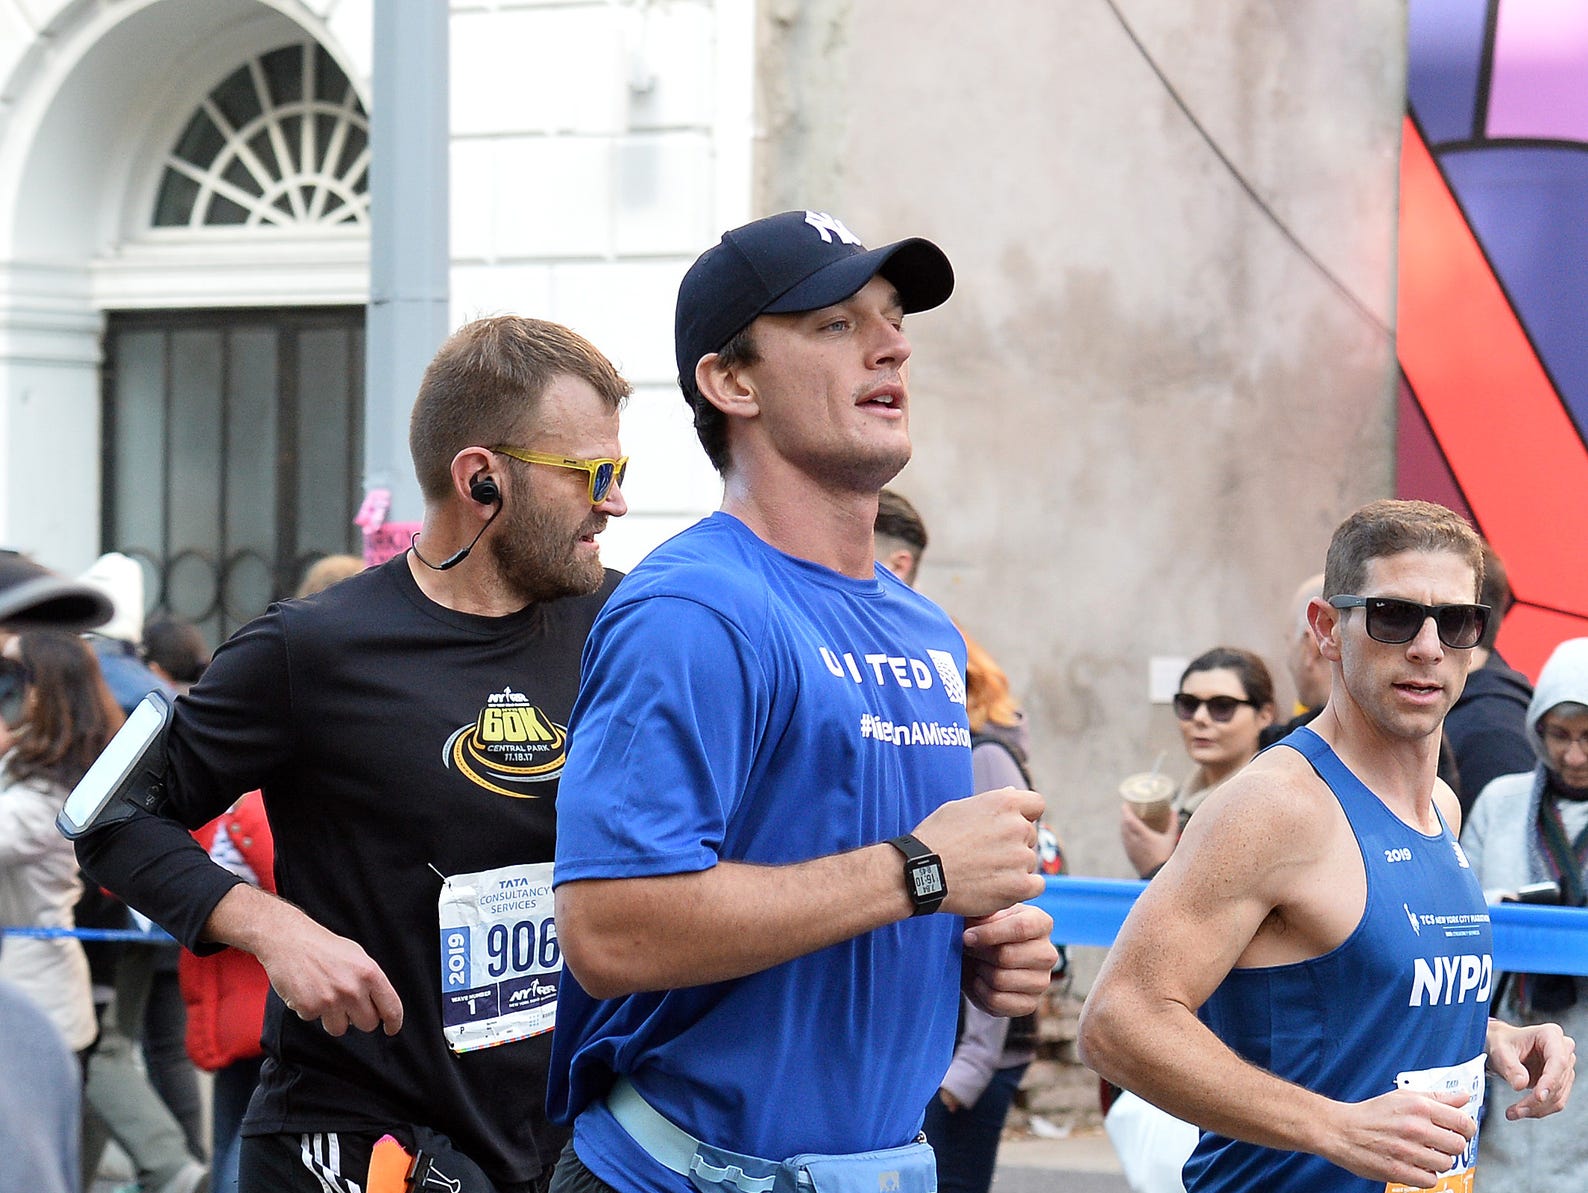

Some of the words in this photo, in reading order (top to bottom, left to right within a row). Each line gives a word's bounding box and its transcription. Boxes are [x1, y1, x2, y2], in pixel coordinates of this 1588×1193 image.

[819, 647, 933, 690] UITED
[482, 707, 554, 741] 60K
[487, 744, 526, 752] CENTRAL
[527, 744, 550, 752] PARK
[504, 753, 533, 761] 11.18.17
[1384, 847, 1412, 863] 2019
[499, 877, 528, 889] TATA
[915, 873, 936, 887] 16:10
[480, 886, 550, 905] CONSULTANCY
[491, 899, 537, 914] SERVICES
[1420, 914, 1435, 925] TCS
[447, 932, 466, 986] 2019
[1408, 954, 1493, 1007] NYPD
[467, 999, 476, 1015] 1
